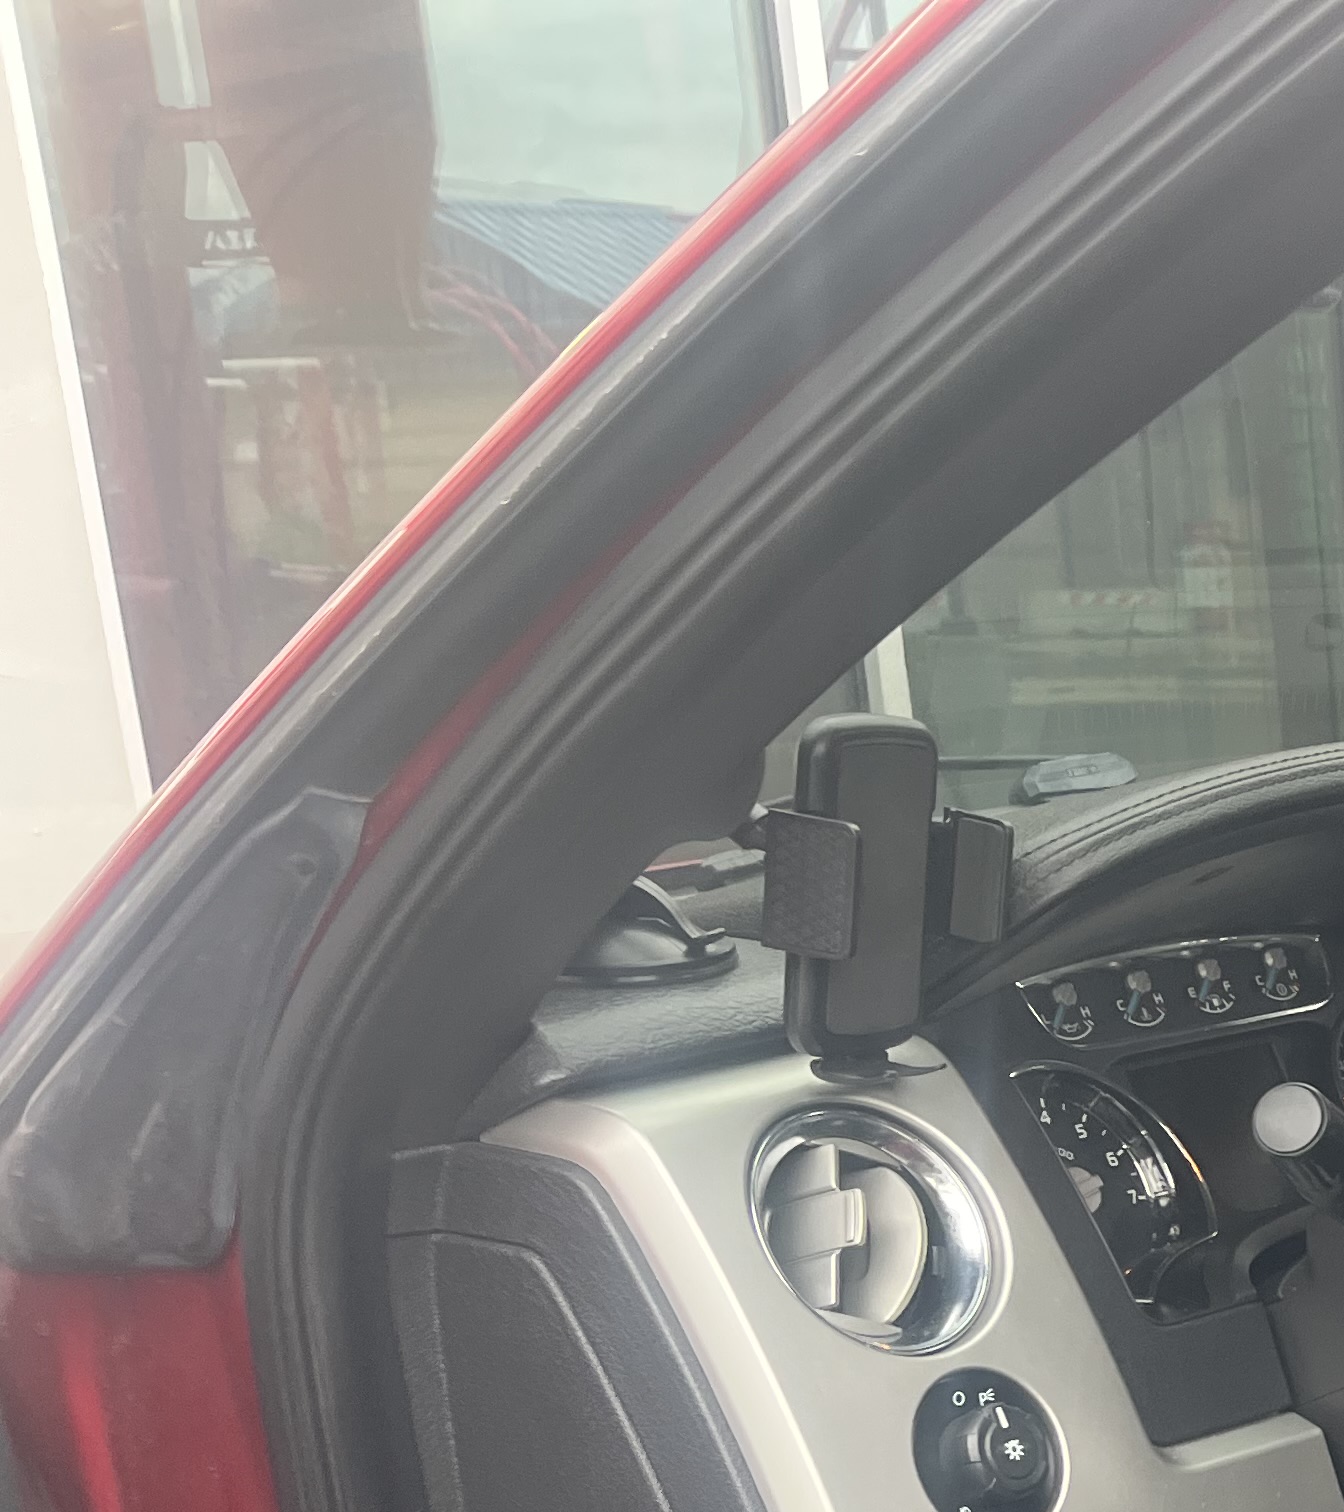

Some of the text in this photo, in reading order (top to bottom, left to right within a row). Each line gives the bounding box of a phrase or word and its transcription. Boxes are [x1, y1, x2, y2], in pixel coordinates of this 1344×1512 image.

[1187, 980, 1232, 998] E F
[1152, 992, 1165, 1004] H
[1080, 1005, 1092, 1018] H
[1040, 1110, 1137, 1205] 4 5 6 7
